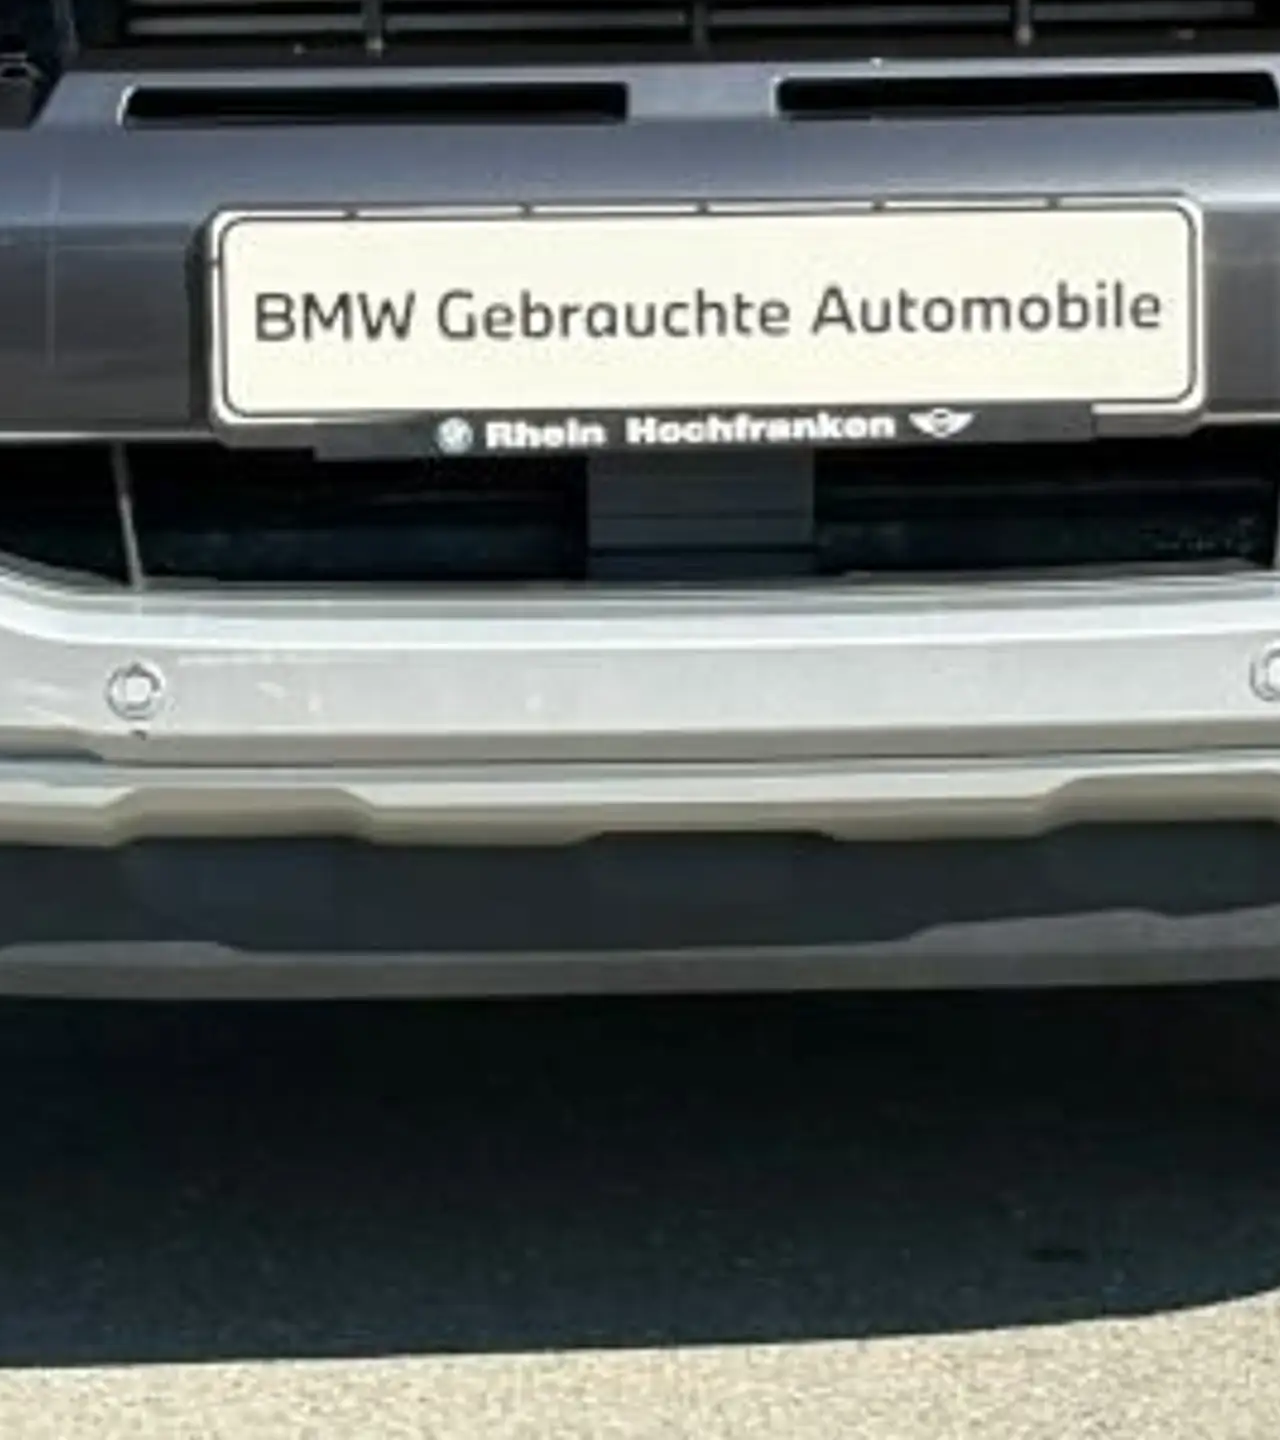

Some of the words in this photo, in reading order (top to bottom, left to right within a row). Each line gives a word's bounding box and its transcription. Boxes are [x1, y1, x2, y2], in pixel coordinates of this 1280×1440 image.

[254, 289, 417, 343] BMW
[436, 287, 791, 342] Gebrauchte
[810, 280, 1163, 336] Automobile
[484, 417, 608, 449] Rhein
[624, 410, 897, 446] Hochfranken
